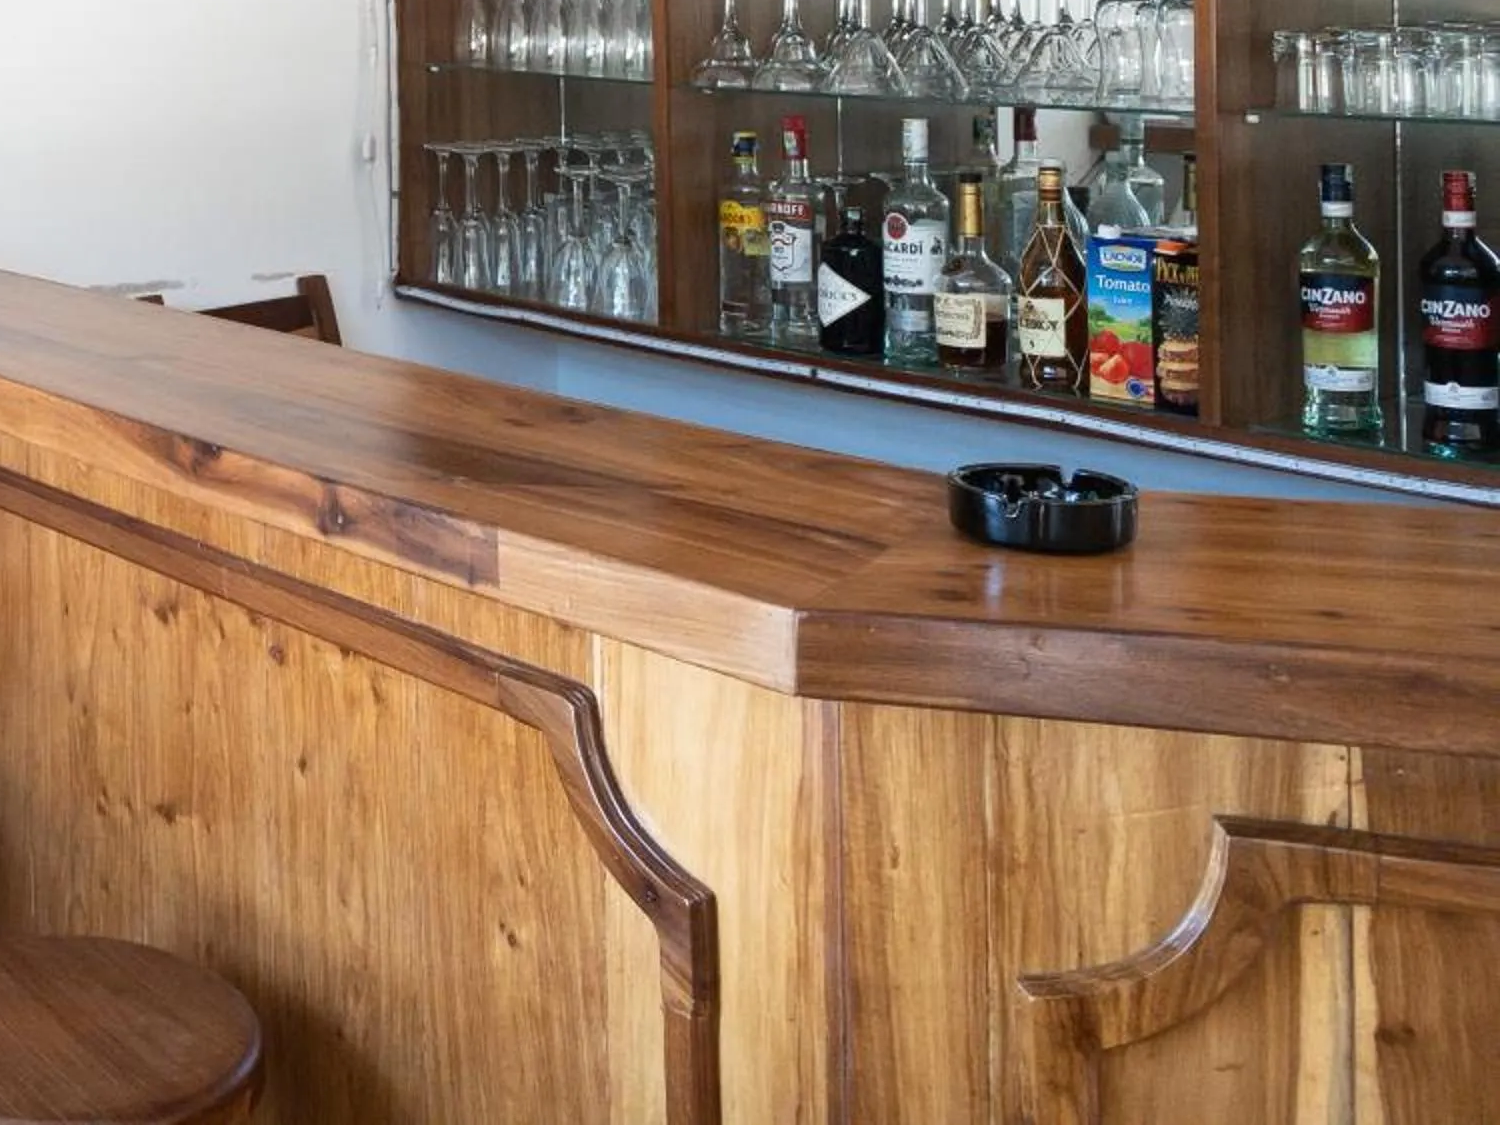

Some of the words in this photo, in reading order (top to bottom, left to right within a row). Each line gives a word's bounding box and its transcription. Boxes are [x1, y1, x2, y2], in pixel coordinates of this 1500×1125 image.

[1095, 275, 1151, 293] Tomato
[1301, 287, 1366, 306] CINZANO
[1421, 300, 1491, 319] CINZANO
